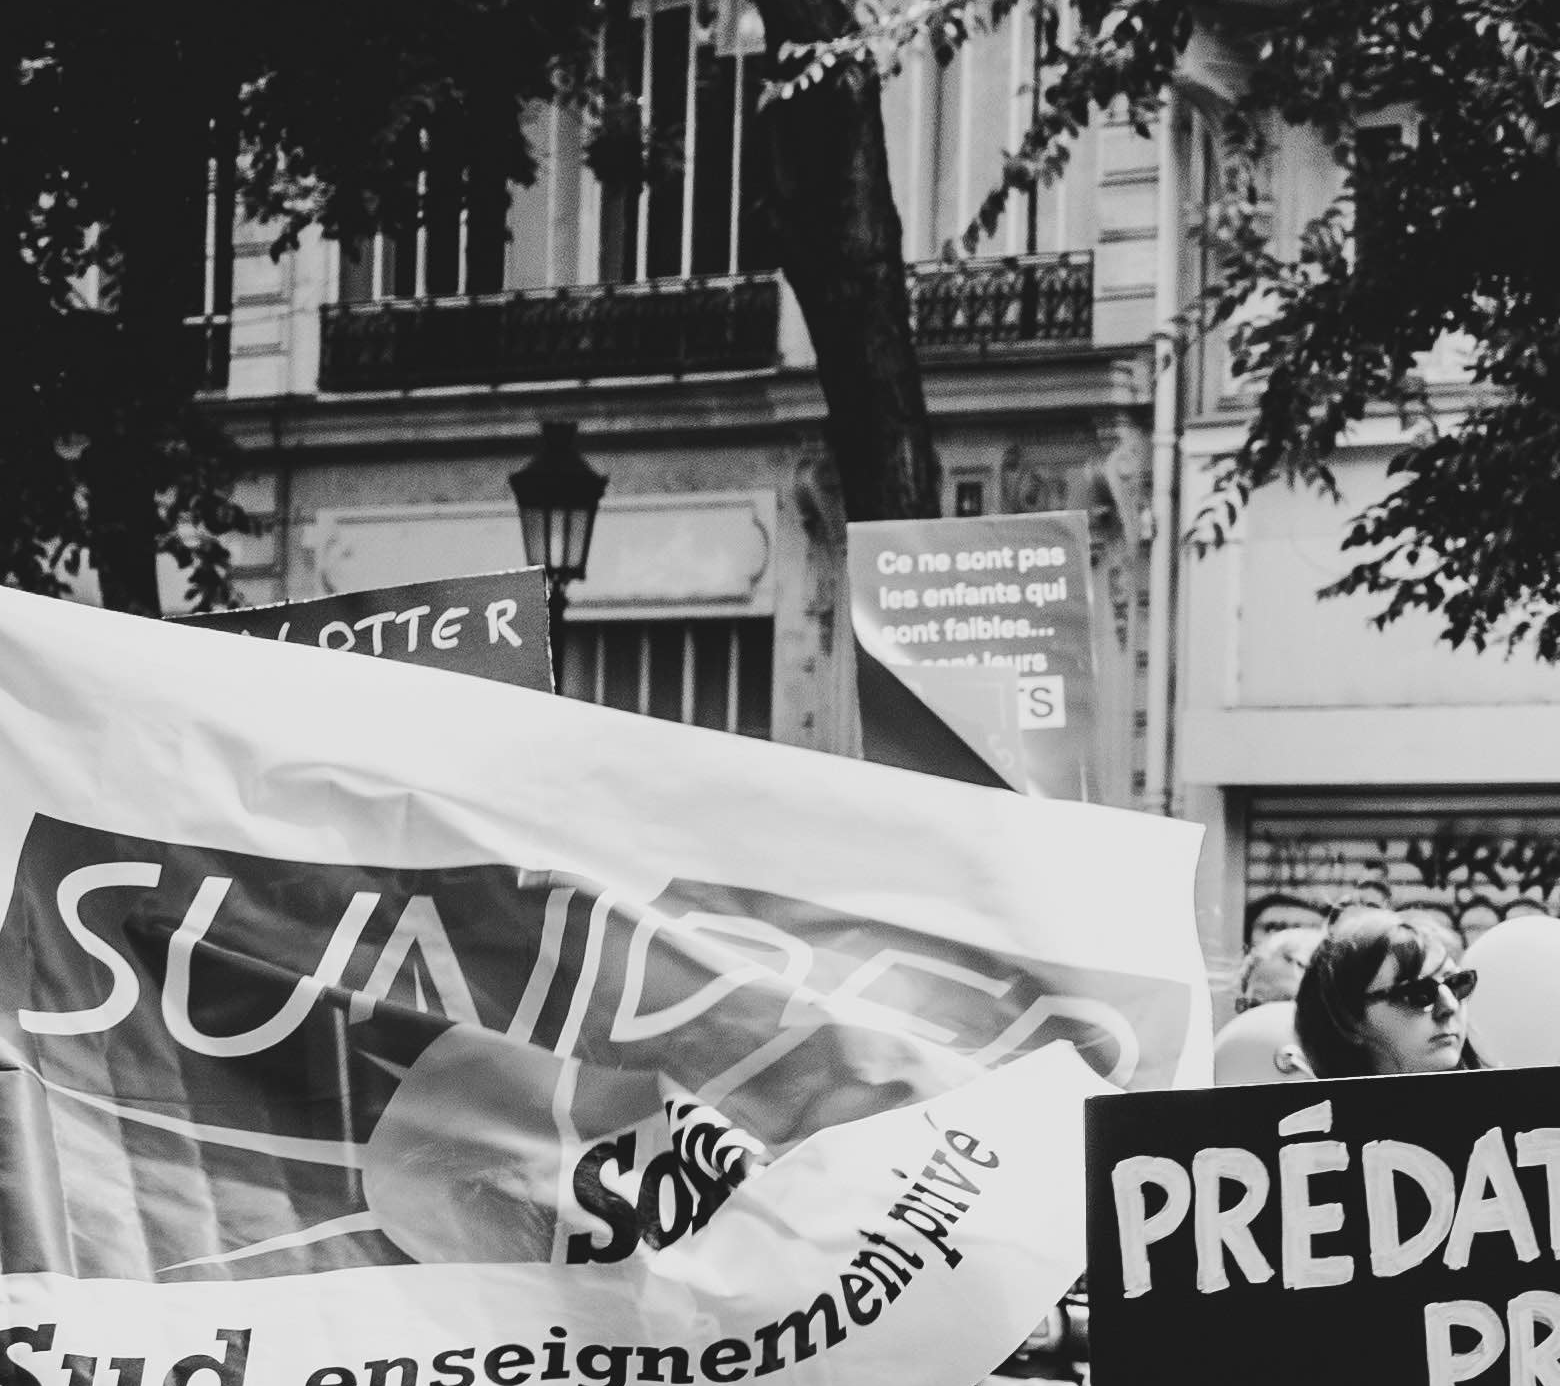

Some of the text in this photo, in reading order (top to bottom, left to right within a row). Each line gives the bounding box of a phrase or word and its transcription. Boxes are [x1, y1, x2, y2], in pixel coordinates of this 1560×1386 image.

[877, 546, 1066, 575] Ce ne sont pas
[879, 577, 1067, 610] les enfants qui
[882, 620, 941, 644] sont
